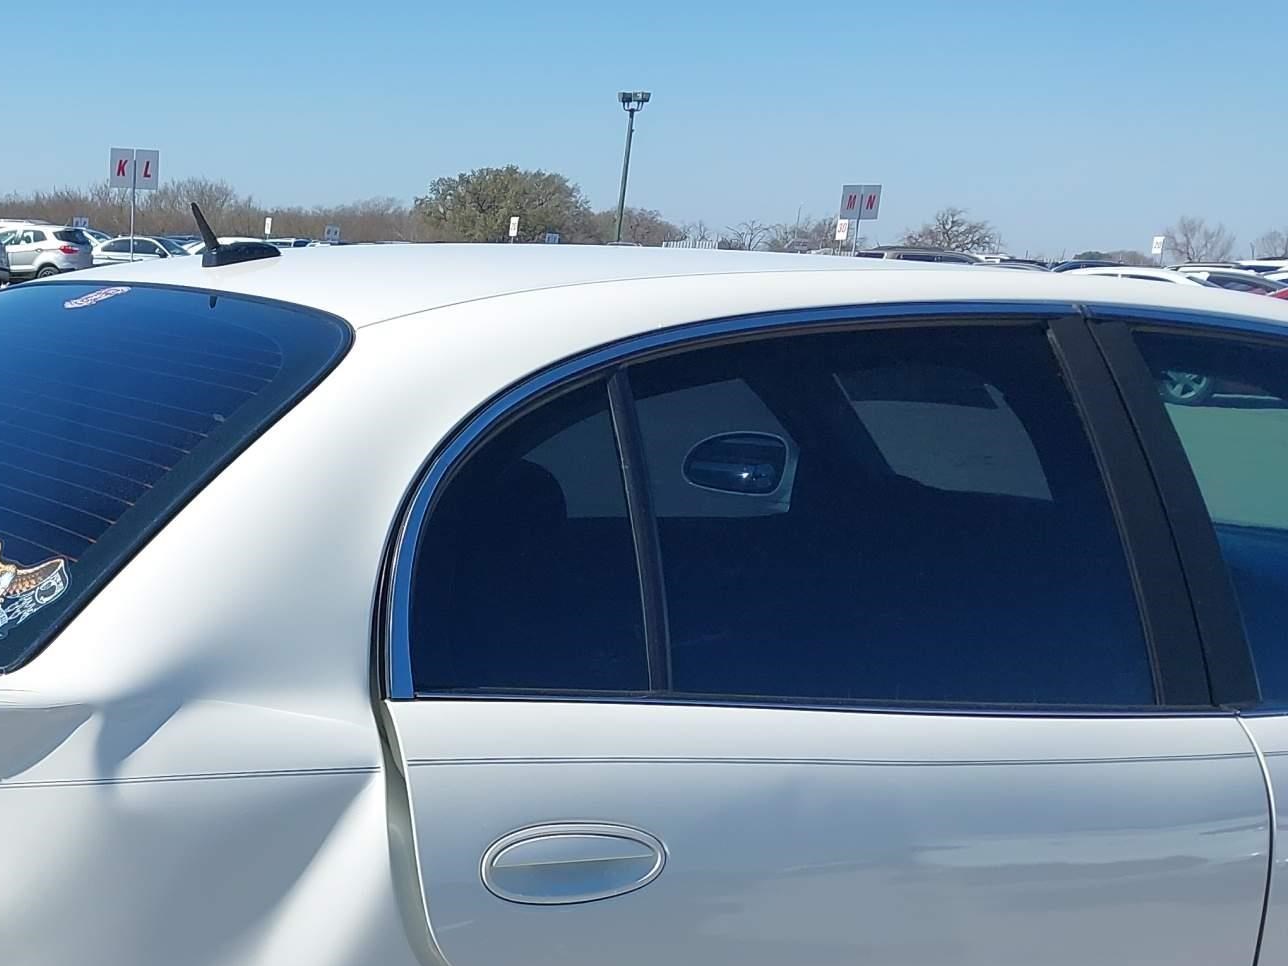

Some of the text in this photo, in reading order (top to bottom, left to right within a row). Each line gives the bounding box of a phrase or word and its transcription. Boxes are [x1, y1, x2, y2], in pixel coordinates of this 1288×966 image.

[116, 159, 152, 178] K L
[846, 194, 877, 211] M N
